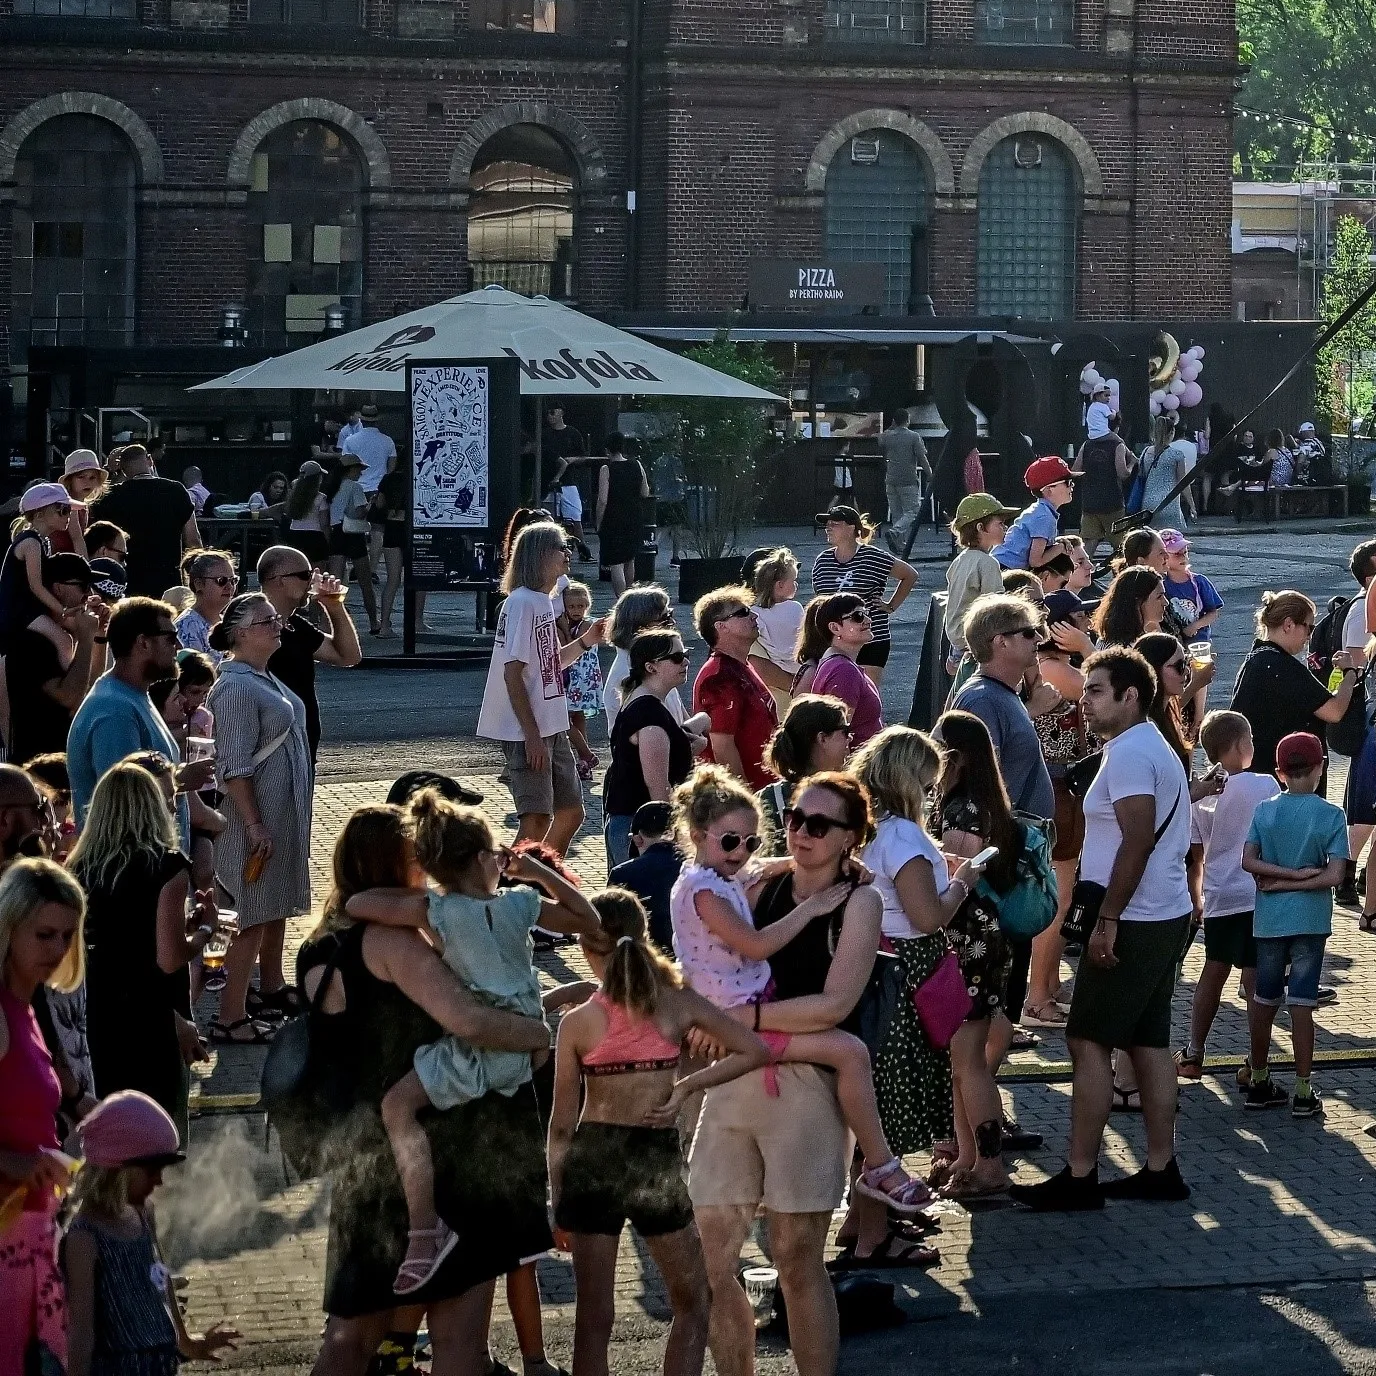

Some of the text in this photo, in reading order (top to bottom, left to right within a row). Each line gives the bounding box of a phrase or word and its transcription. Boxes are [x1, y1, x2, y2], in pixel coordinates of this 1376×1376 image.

[798, 269, 836, 287] PIZZA
[789, 289, 798, 299] BY
[799, 289, 824, 299] PERTHO
[500, 347, 664, 389] kofola
